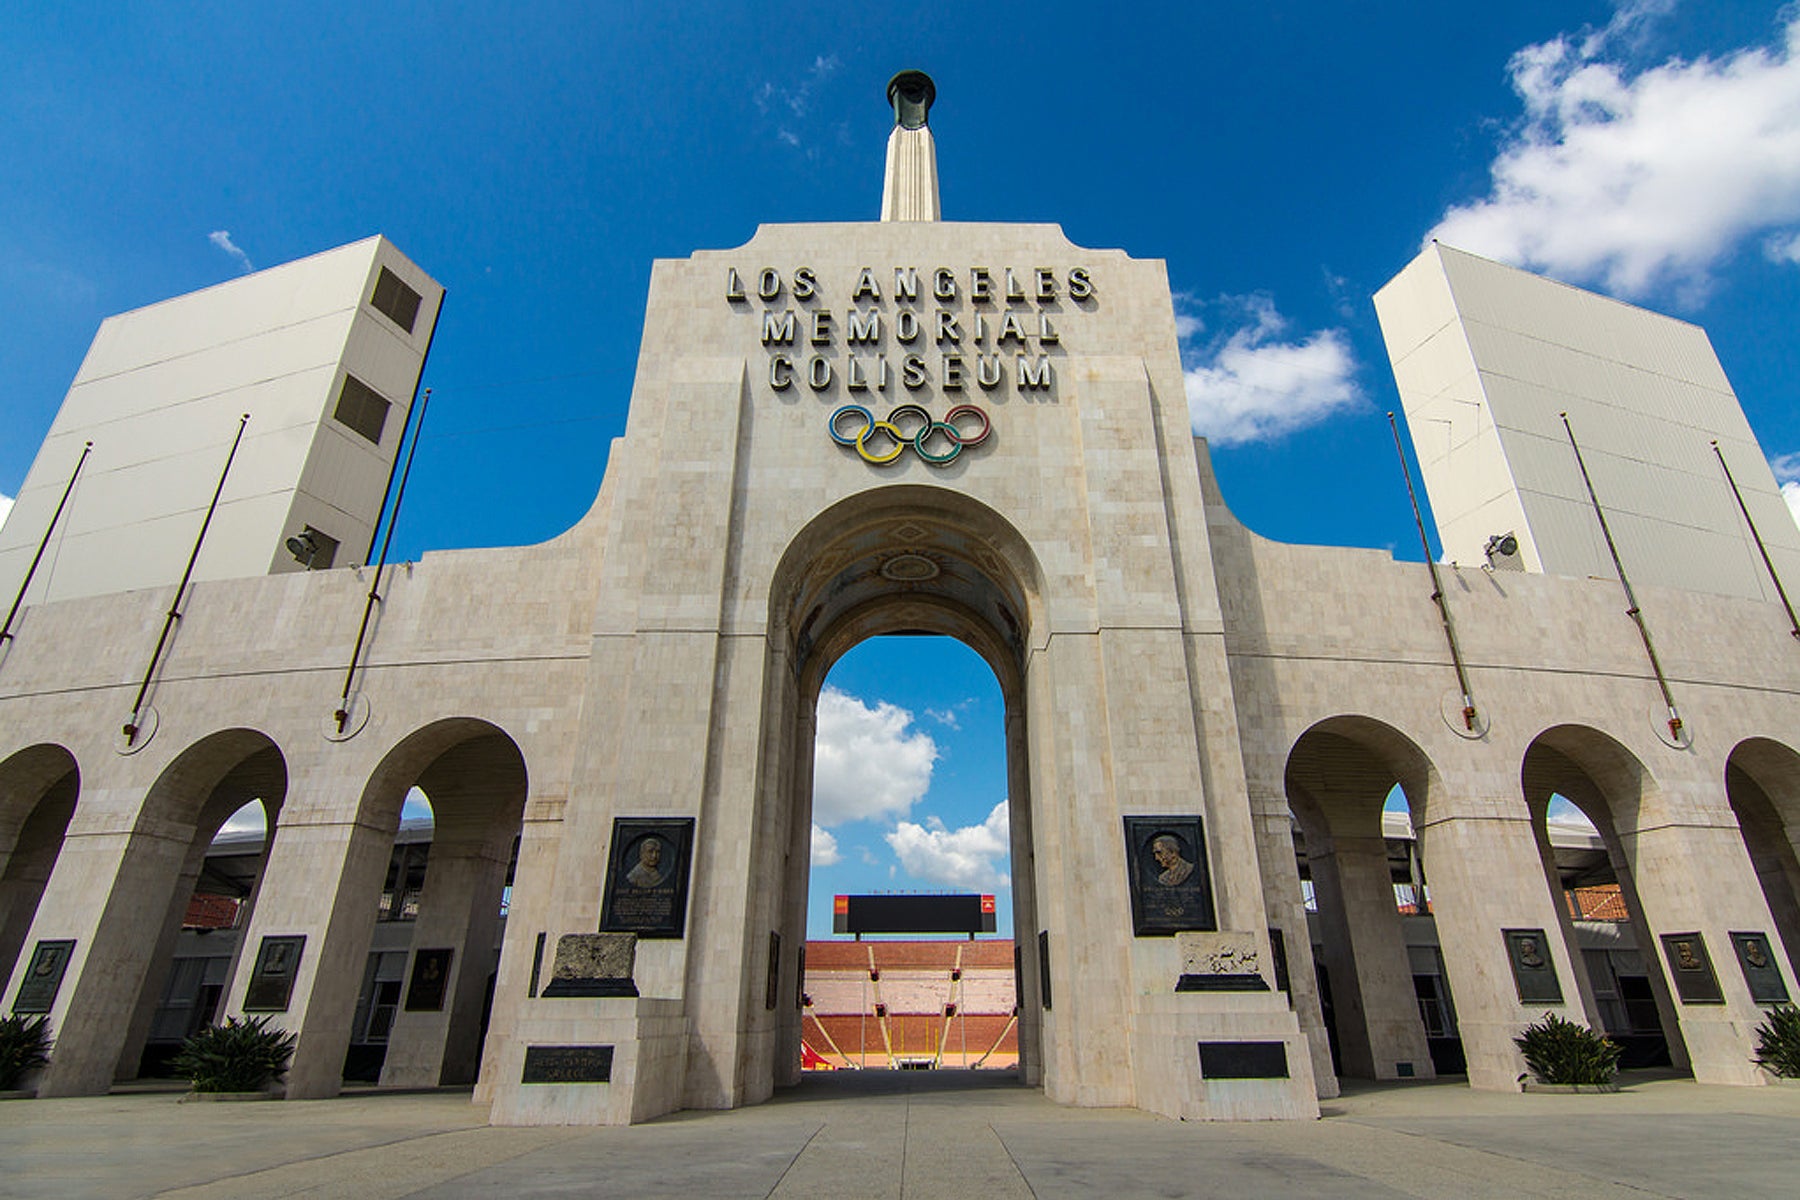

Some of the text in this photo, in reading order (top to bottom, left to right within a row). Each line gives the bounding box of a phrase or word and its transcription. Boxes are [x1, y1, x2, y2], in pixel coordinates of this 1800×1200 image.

[726, 267, 1093, 303] LOS ANGELES
[761, 308, 1060, 346] MEMORIAL
[769, 353, 1053, 393] COLISEUM
